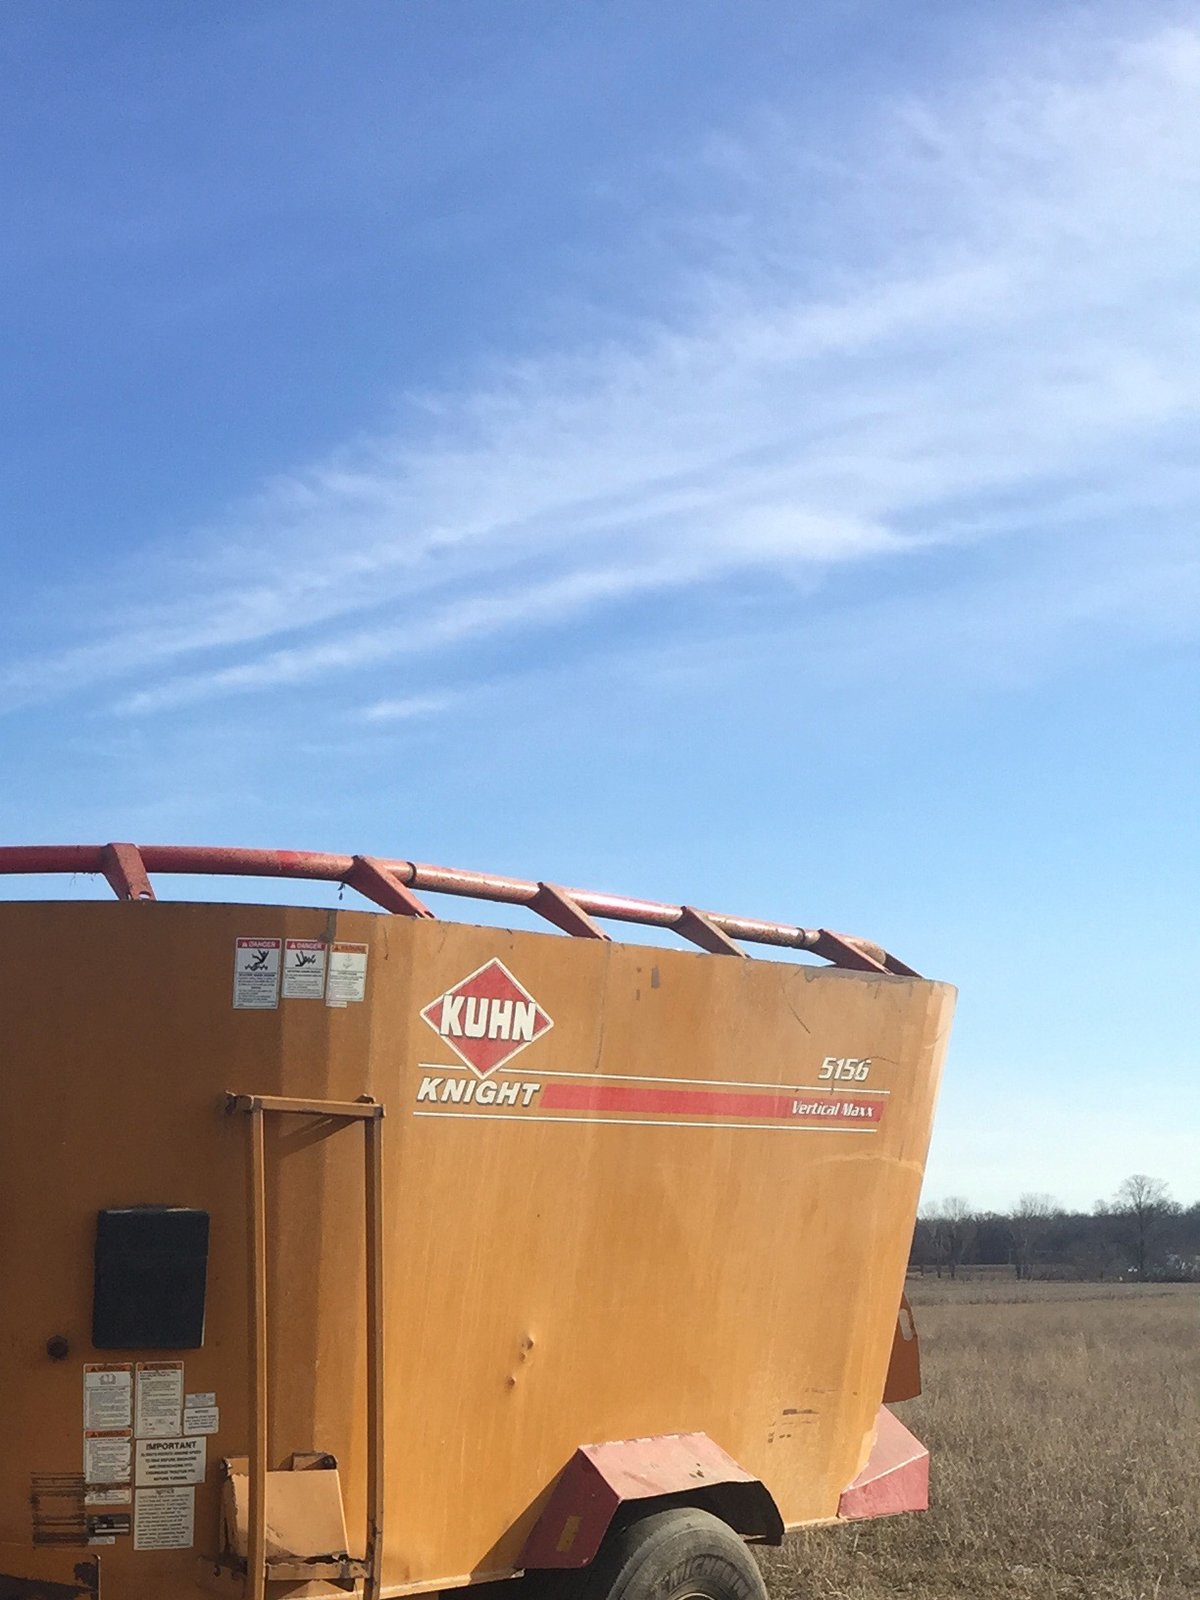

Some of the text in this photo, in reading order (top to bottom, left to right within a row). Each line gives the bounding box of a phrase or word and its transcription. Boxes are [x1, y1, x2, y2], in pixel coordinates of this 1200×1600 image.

[440, 994, 535, 1042] KUHN
[817, 1056, 872, 1082] 5156
[416, 1077, 539, 1107] KNIGHT
[792, 1100, 875, 1118] Vertical Maxx
[146, 1440, 197, 1450] IMPORTANT
